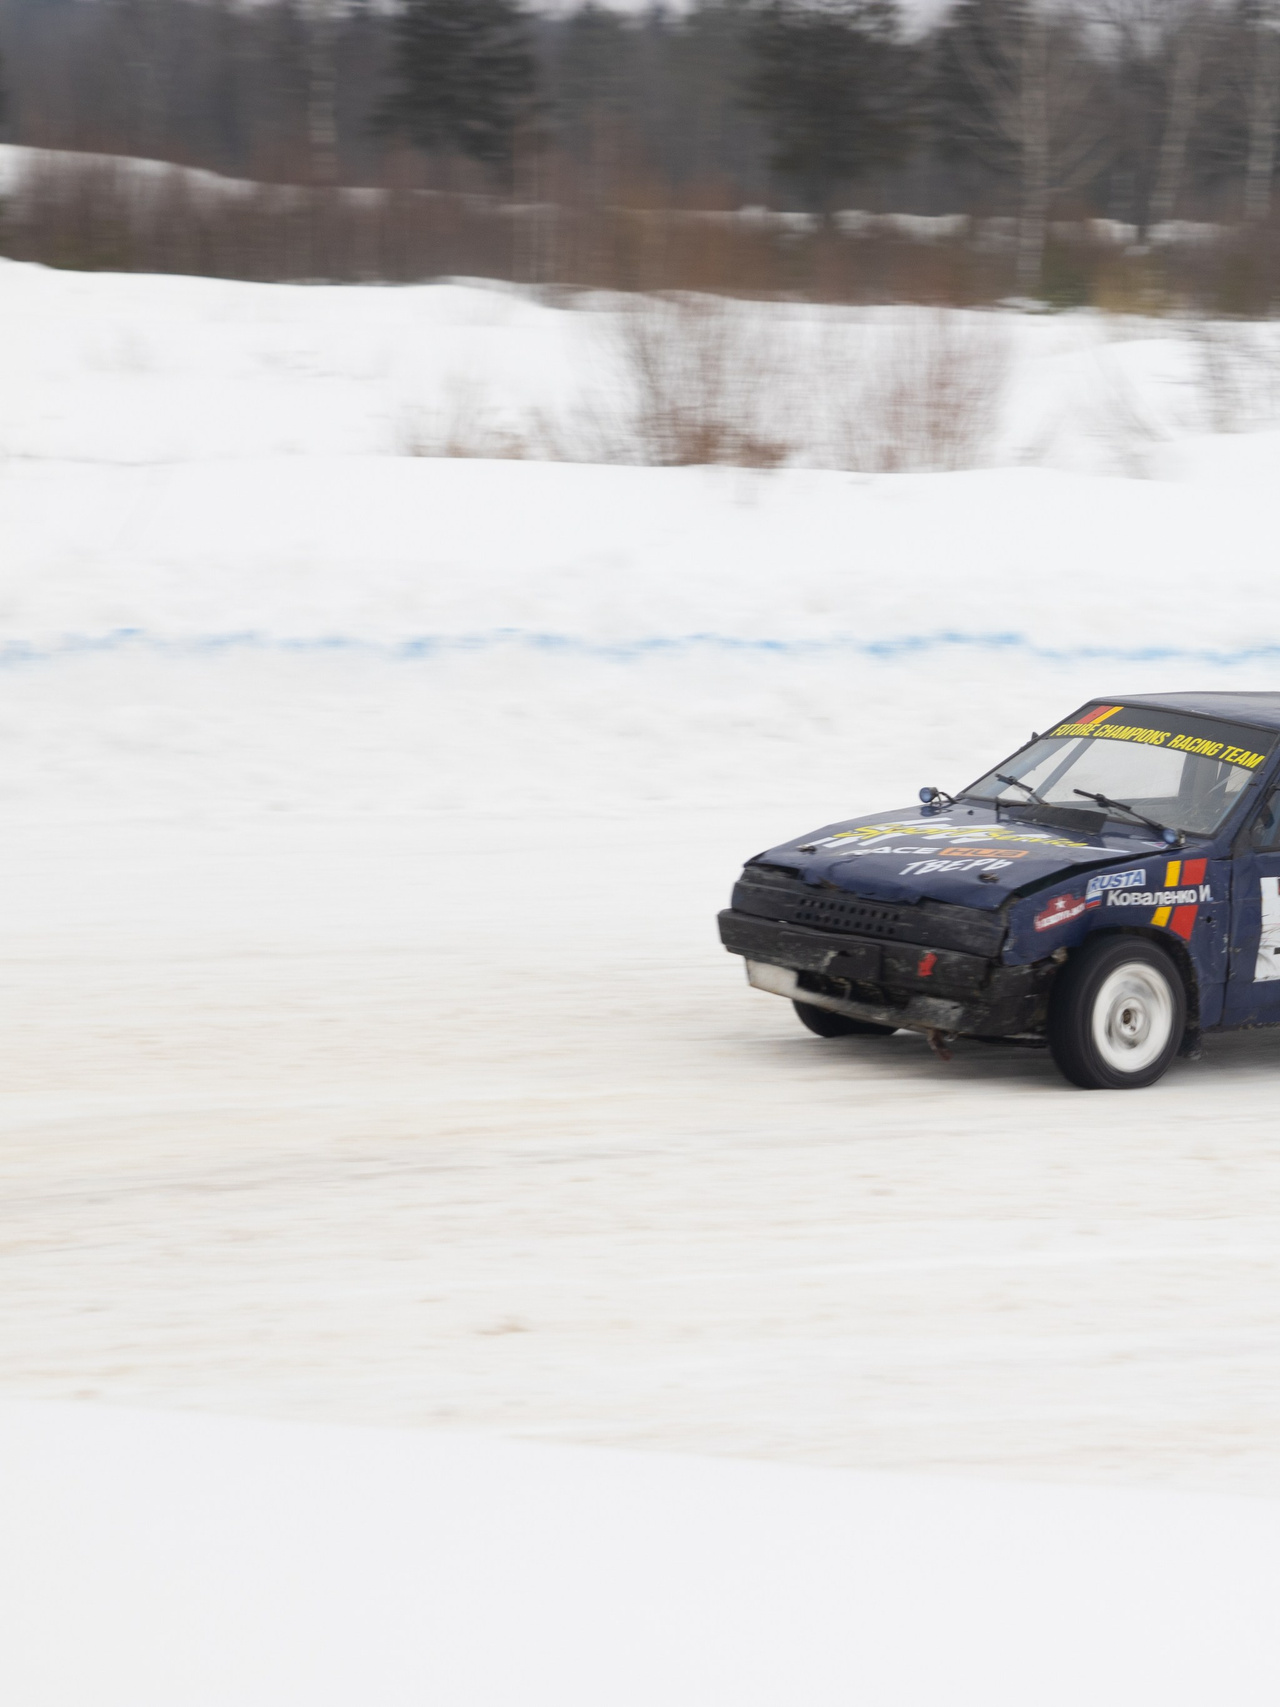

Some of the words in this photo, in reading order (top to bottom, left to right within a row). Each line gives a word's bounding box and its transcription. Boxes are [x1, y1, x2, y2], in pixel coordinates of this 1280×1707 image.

[1050, 723, 1100, 737] FUTURE
[1093, 724, 1171, 745] CHAMPIONS
[1167, 734, 1224, 757] RACING
[1219, 746, 1266, 769] TEAM
[945, 847, 1022, 857] HUB
[1090, 870, 1145, 890] RUSTA
[1106, 889, 1197, 906] Коваленко
